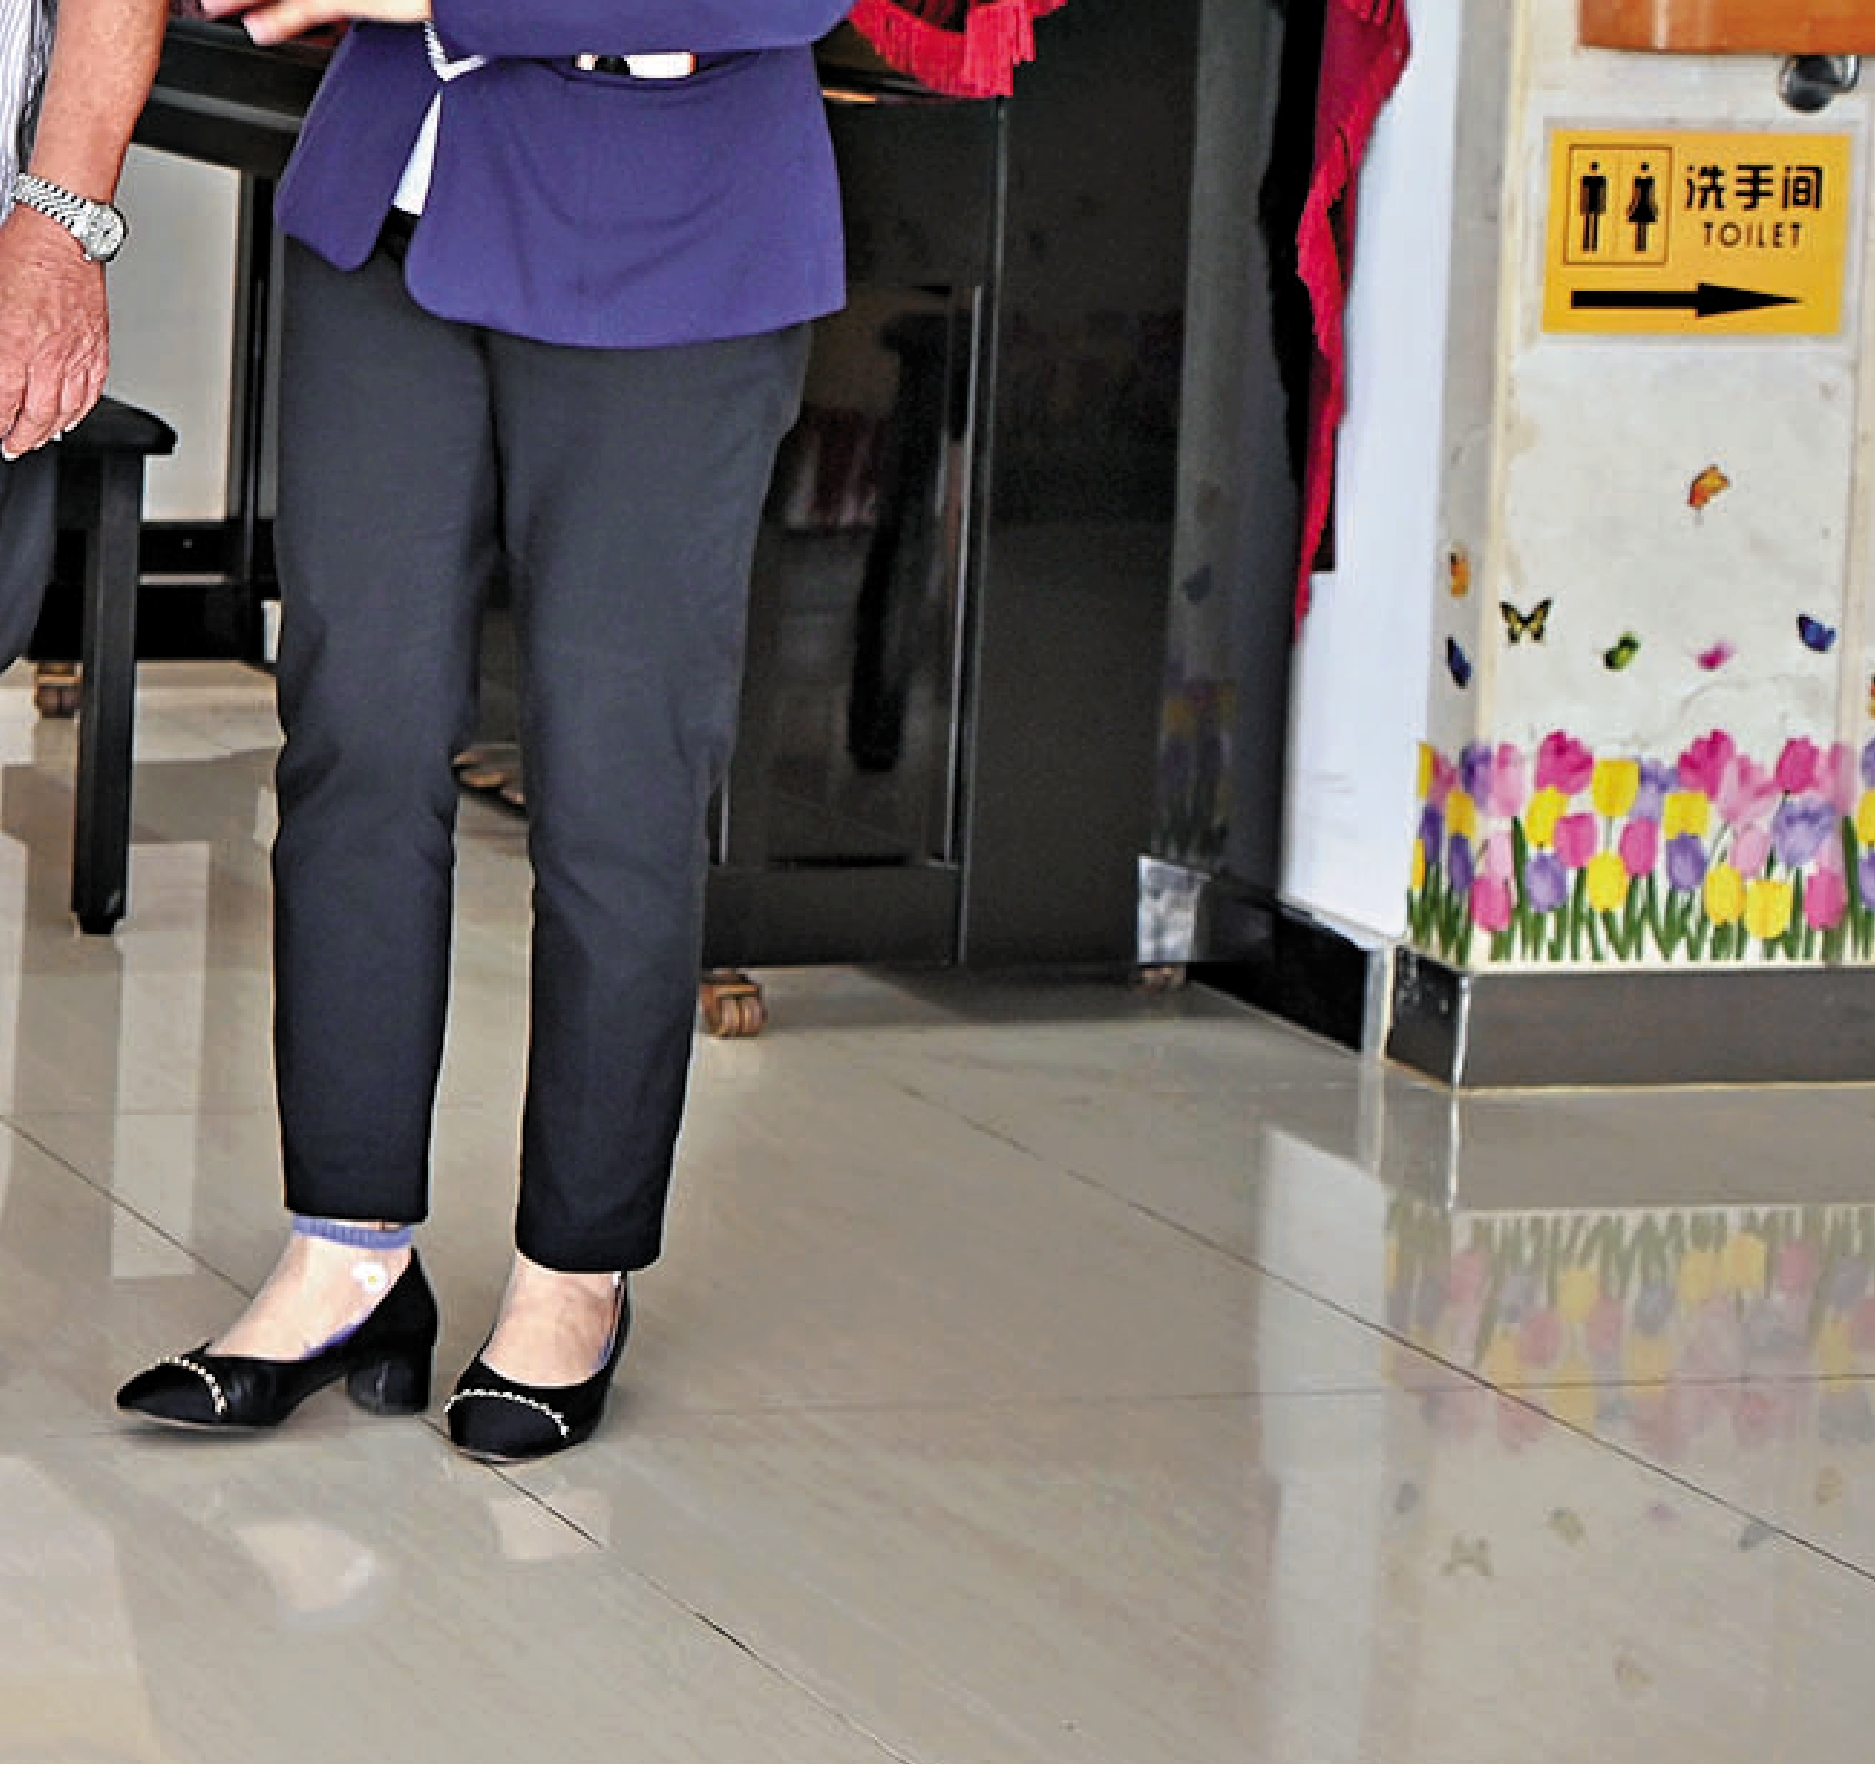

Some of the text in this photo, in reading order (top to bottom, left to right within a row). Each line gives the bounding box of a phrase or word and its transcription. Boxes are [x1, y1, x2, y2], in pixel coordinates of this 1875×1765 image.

[1685, 165, 1824, 211] 洗手间
[1703, 221, 1802, 249] TOILET
